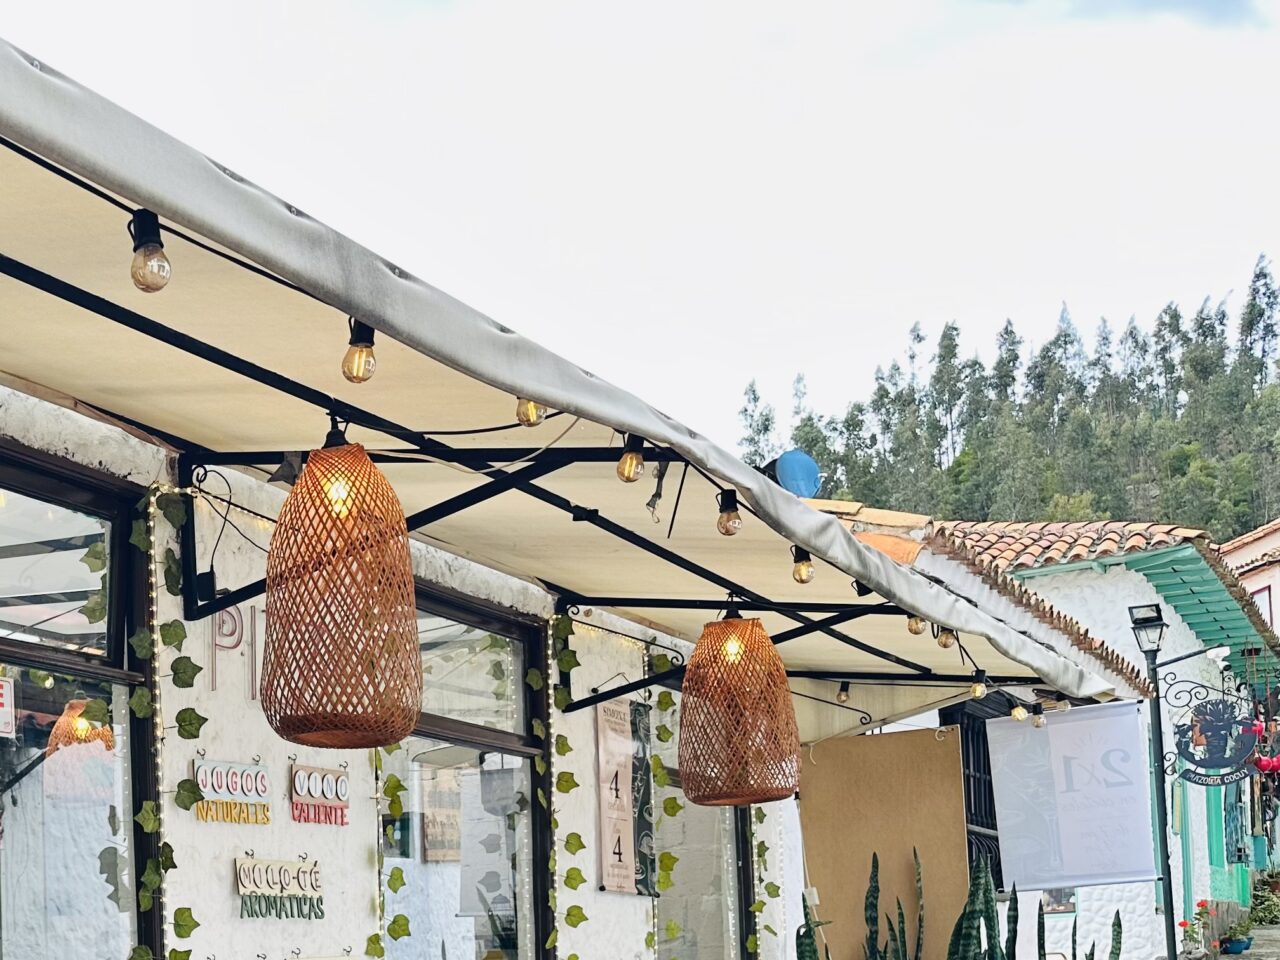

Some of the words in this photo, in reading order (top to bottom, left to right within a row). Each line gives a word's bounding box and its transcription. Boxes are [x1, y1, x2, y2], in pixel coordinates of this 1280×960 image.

[198, 767, 268, 796] JUGOS
[297, 773, 348, 798] VINO
[609, 769, 621, 800] 4
[195, 800, 271, 825] NATURALES
[612, 834, 623, 863] 4
